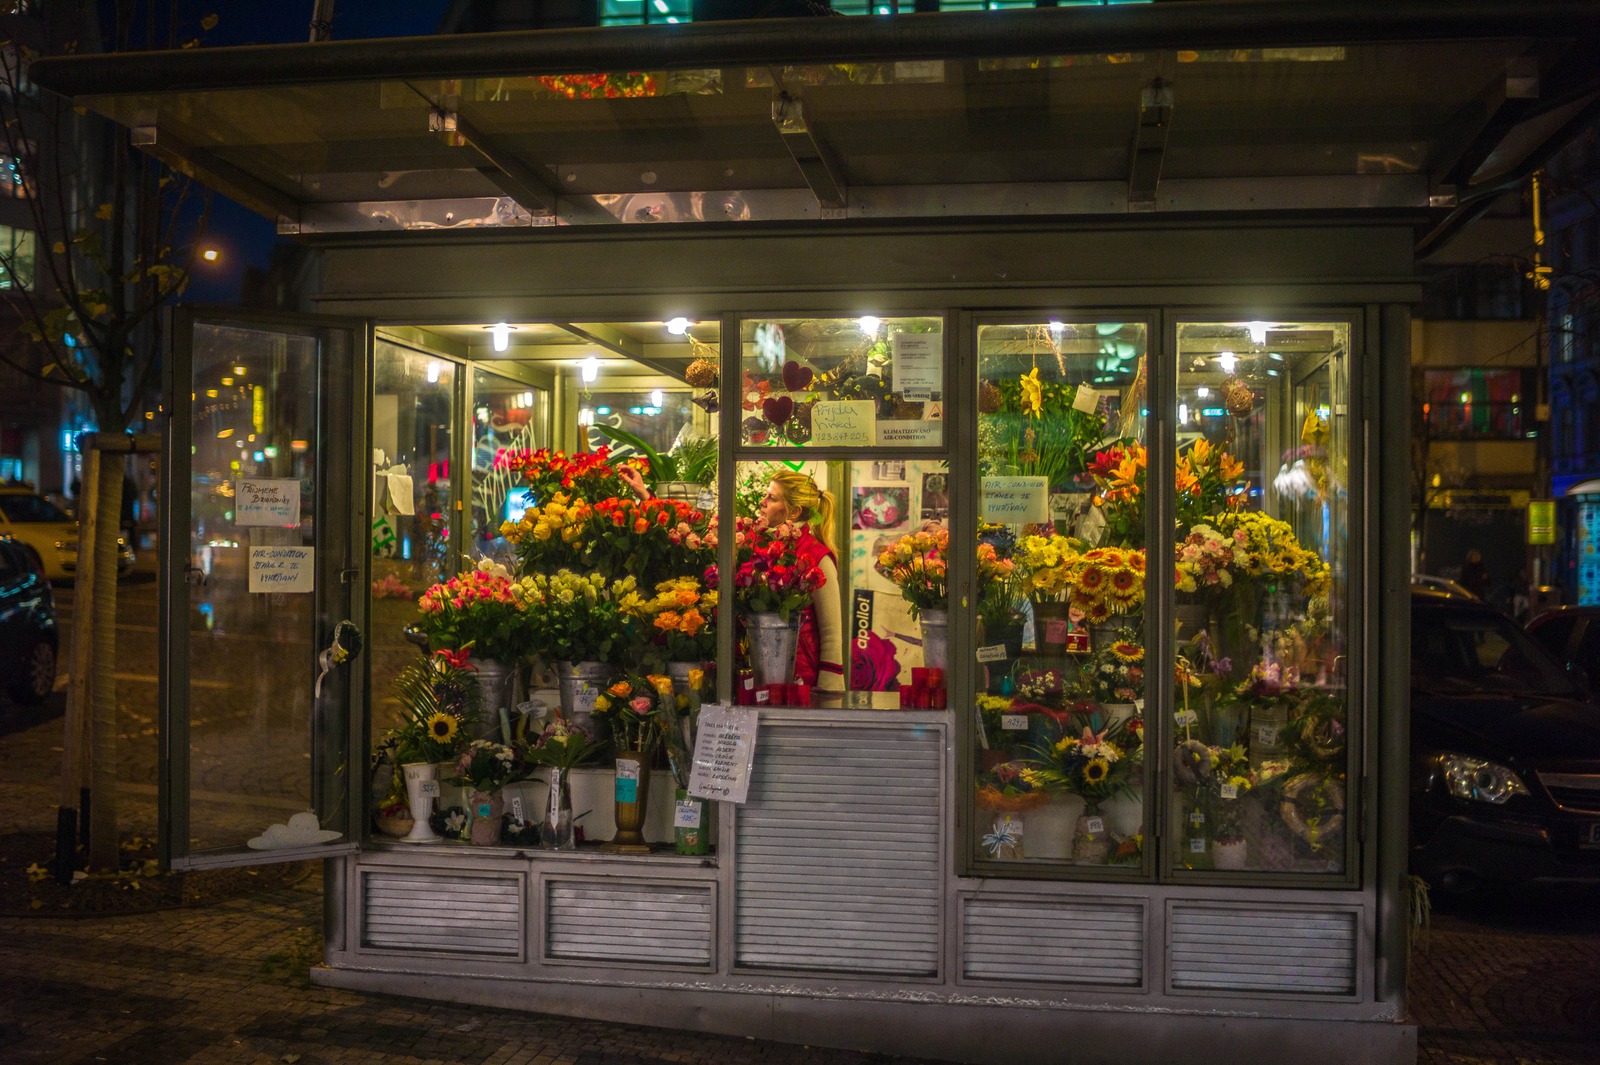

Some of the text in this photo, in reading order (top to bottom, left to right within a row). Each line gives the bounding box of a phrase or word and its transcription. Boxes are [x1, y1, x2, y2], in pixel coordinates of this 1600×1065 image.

[814, 402, 858, 422] Přijdu
[815, 417, 857, 431] hned
[856, 597, 870, 649] apollo!
